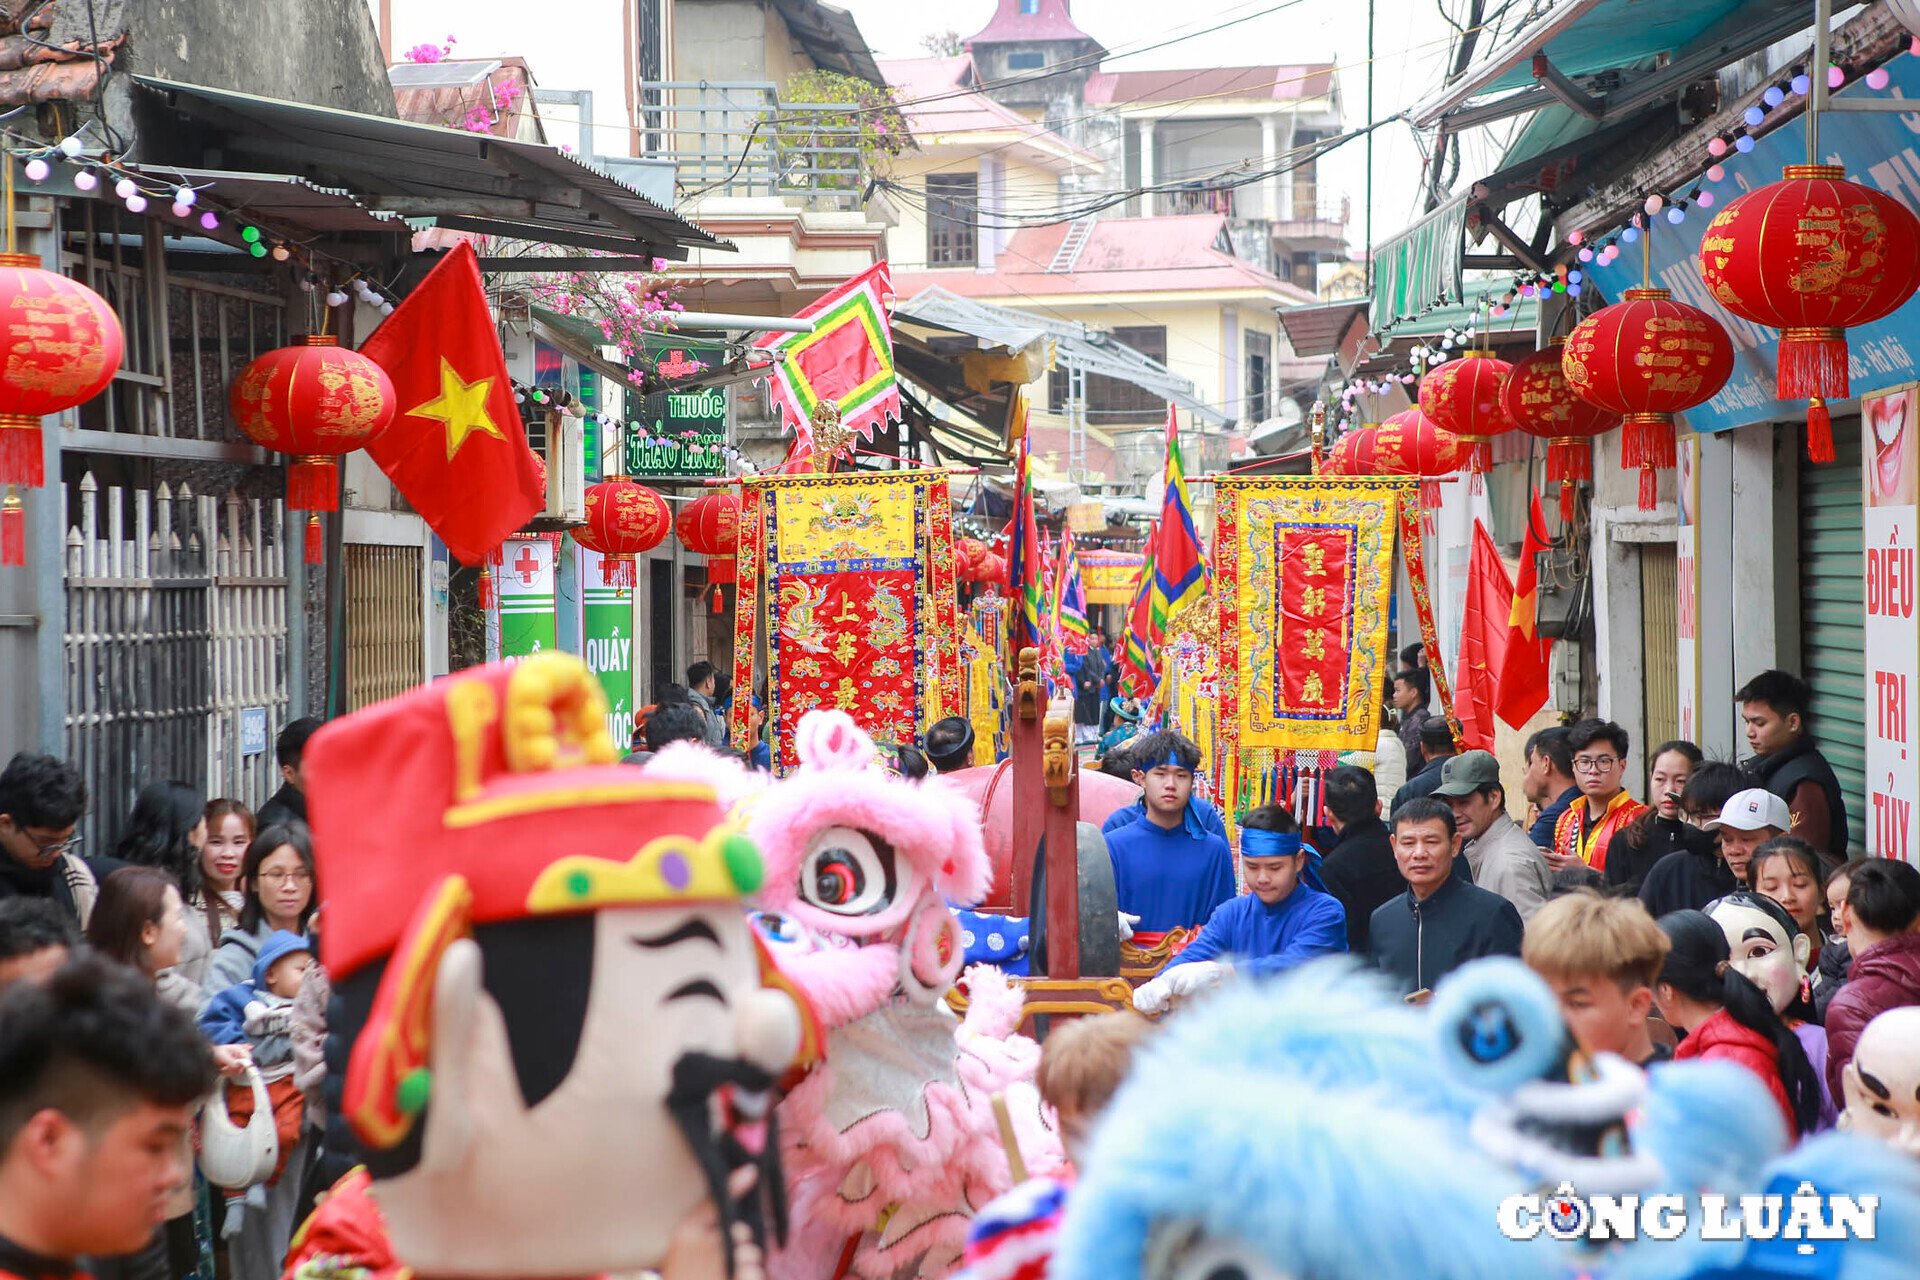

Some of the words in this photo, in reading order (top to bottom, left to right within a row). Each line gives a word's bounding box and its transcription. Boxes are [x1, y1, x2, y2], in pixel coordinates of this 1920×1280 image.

[1798, 219, 1841, 232] Khang
[1644, 315, 1708, 332] Chúc
[668, 388, 723, 418] THUỐC
[1867, 524, 1914, 620] ĐIỀU
[586, 626, 631, 677] QUẦY
[1875, 670, 1907, 760] TRỊ
[1872, 771, 1911, 860] TỦY
